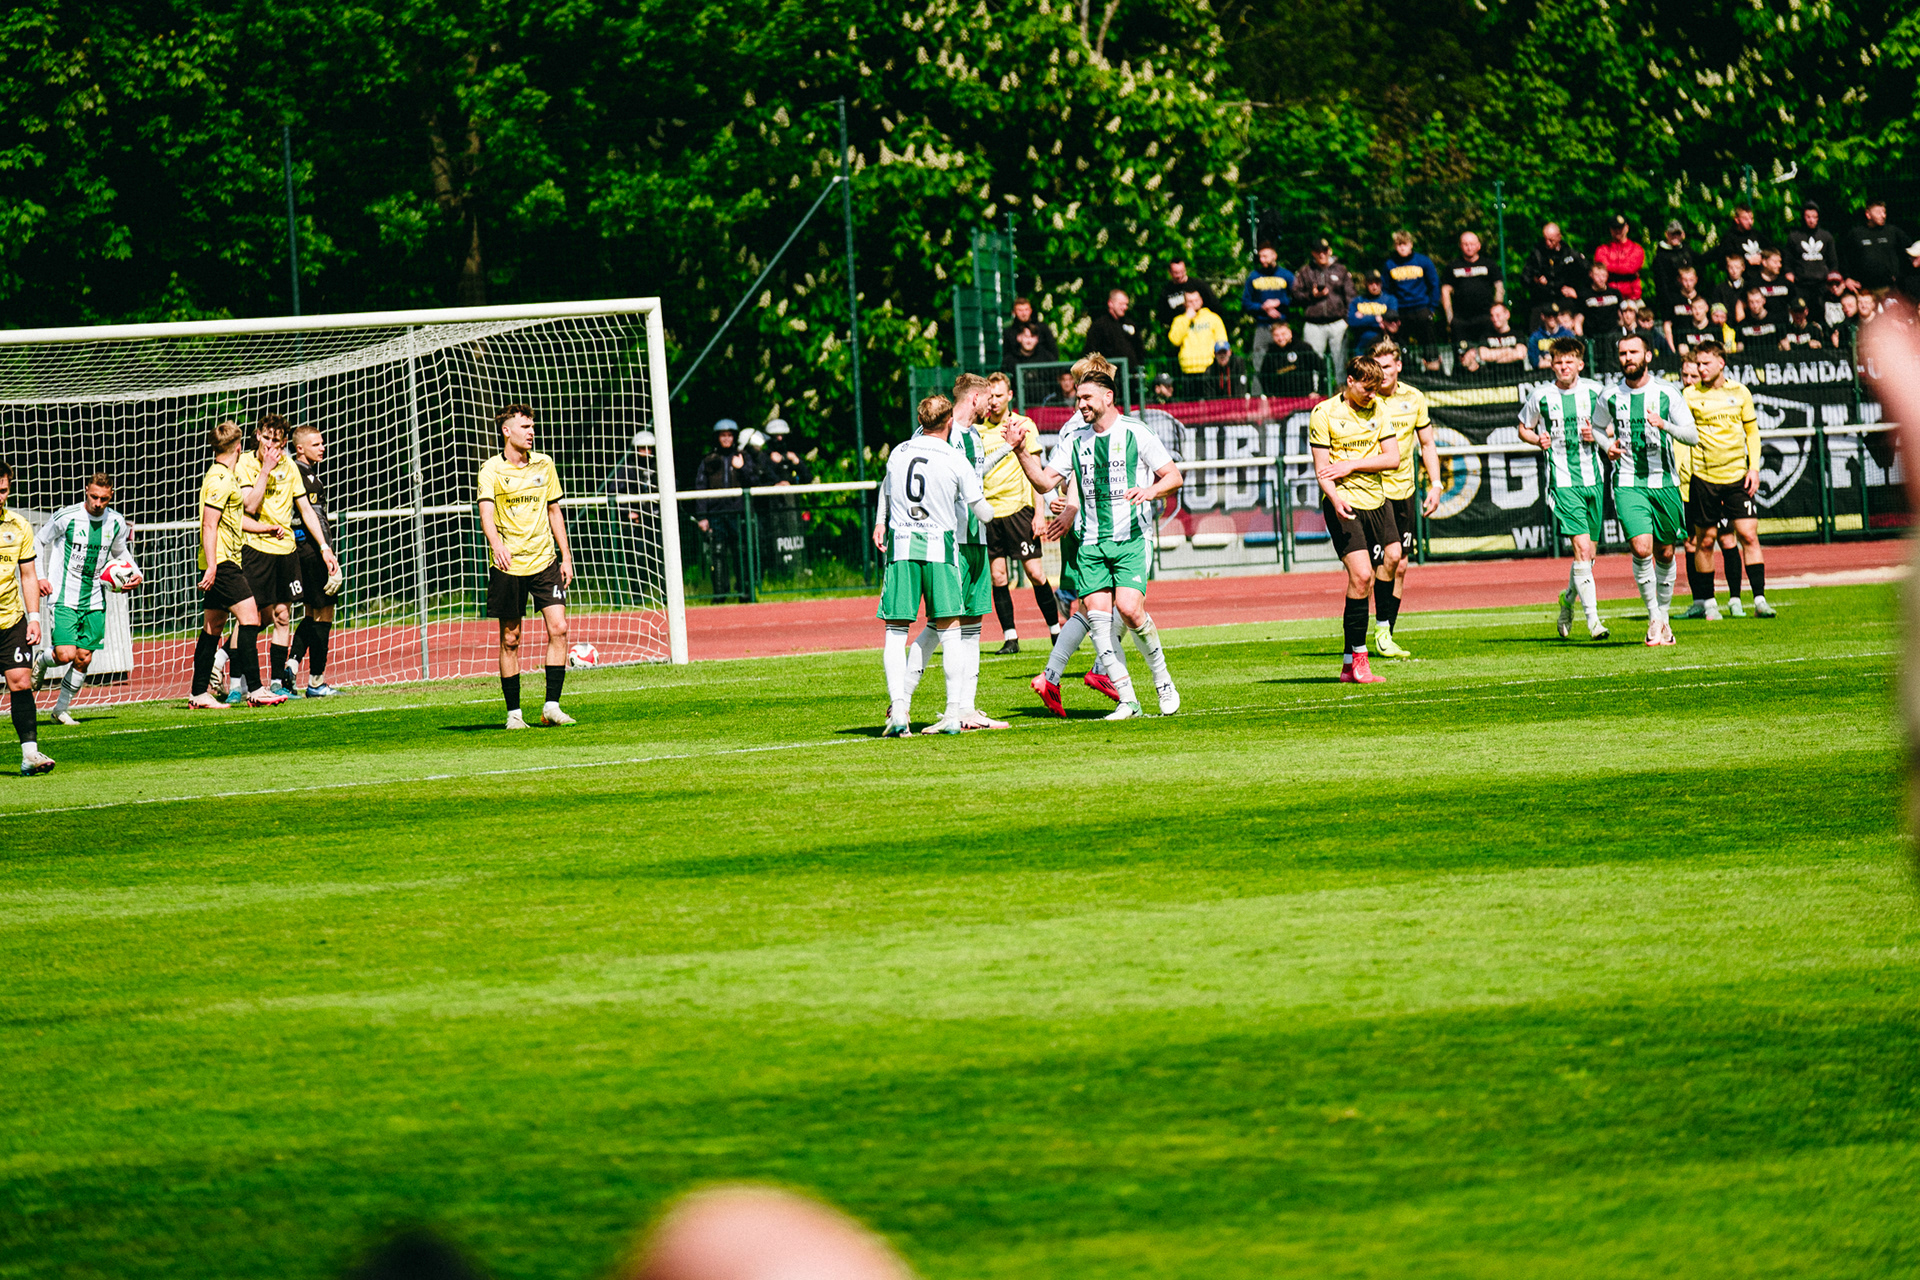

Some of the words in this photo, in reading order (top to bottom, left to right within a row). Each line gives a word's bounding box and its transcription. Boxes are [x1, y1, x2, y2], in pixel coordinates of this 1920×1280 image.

[1764, 359, 1853, 385] BANDA
[905, 455, 930, 504] 6
[1743, 500, 1752, 516] 7
[1402, 531, 1413, 548] 21
[1020, 541, 1030, 556] 3
[1373, 543, 1382, 560] 9
[289, 580, 304, 596] 18
[552, 584, 563, 600] 4
[13, 646, 25, 663] 6
